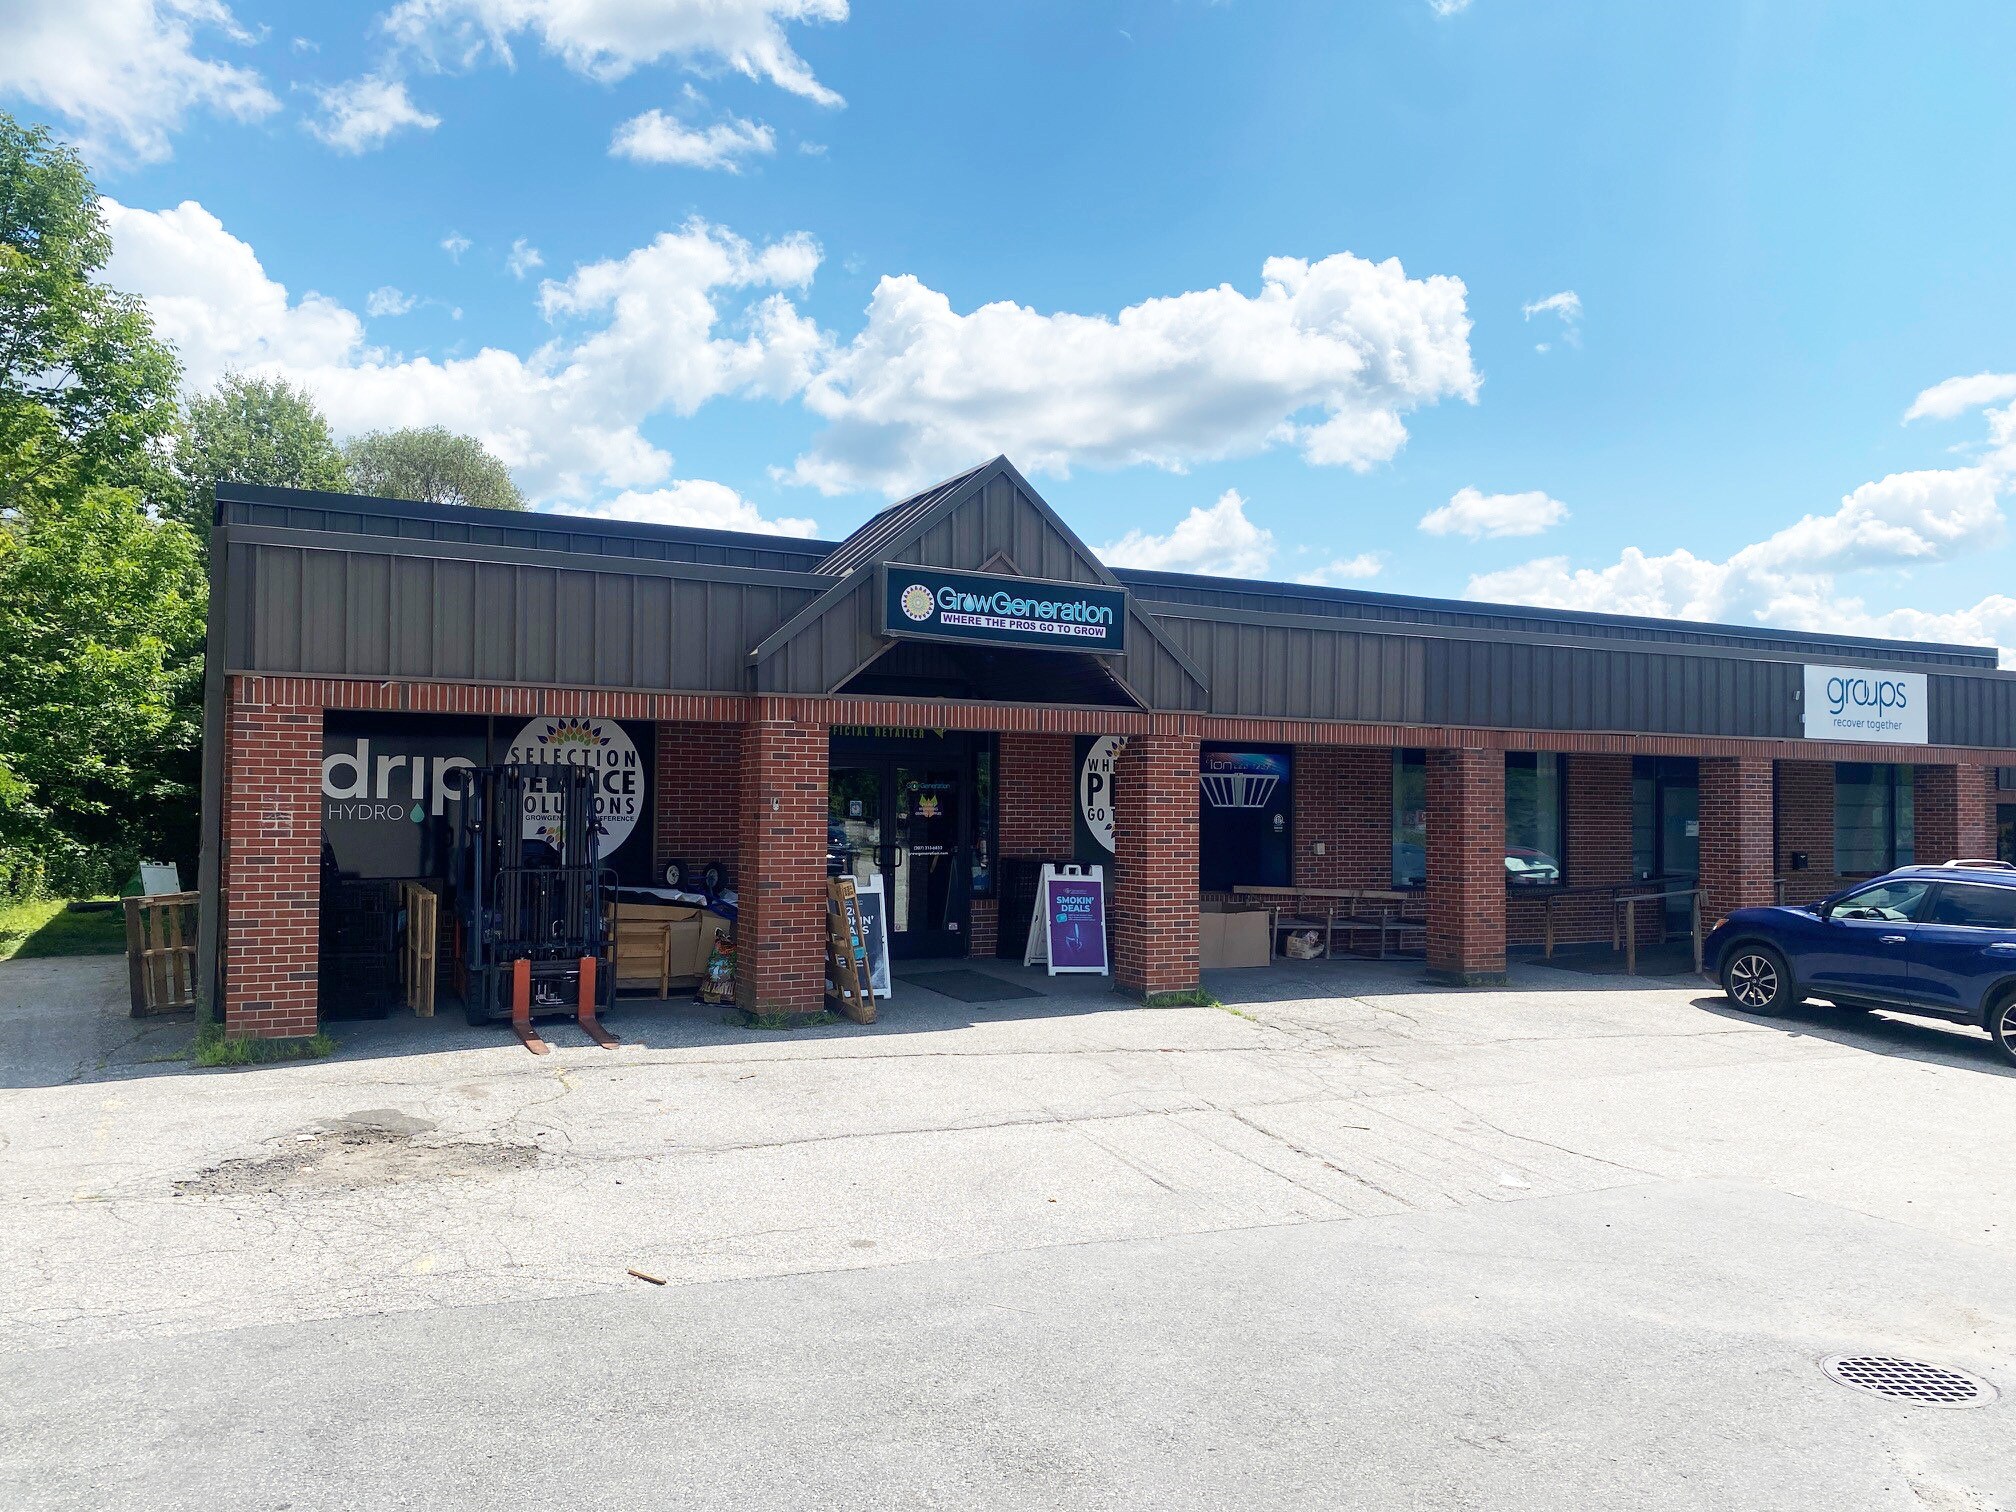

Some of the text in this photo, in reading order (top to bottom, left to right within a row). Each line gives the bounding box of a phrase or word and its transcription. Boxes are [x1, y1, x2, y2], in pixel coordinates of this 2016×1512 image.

[937, 587, 1112, 624] GrowGeneration
[943, 614, 1104, 636] WHERE THE PROS GO TO GROW
[1827, 677, 1907, 717] groups
[1833, 717, 1902, 731] recover together
[874, 728, 924, 738] RETAILER
[510, 747, 636, 767] SELECTION
[322, 738, 477, 816] drip
[328, 804, 404, 821] HYDRO
[1087, 807, 1104, 821] GO
[1056, 896, 1095, 904] SMOKIN'
[1061, 904, 1091, 912] DEALS
